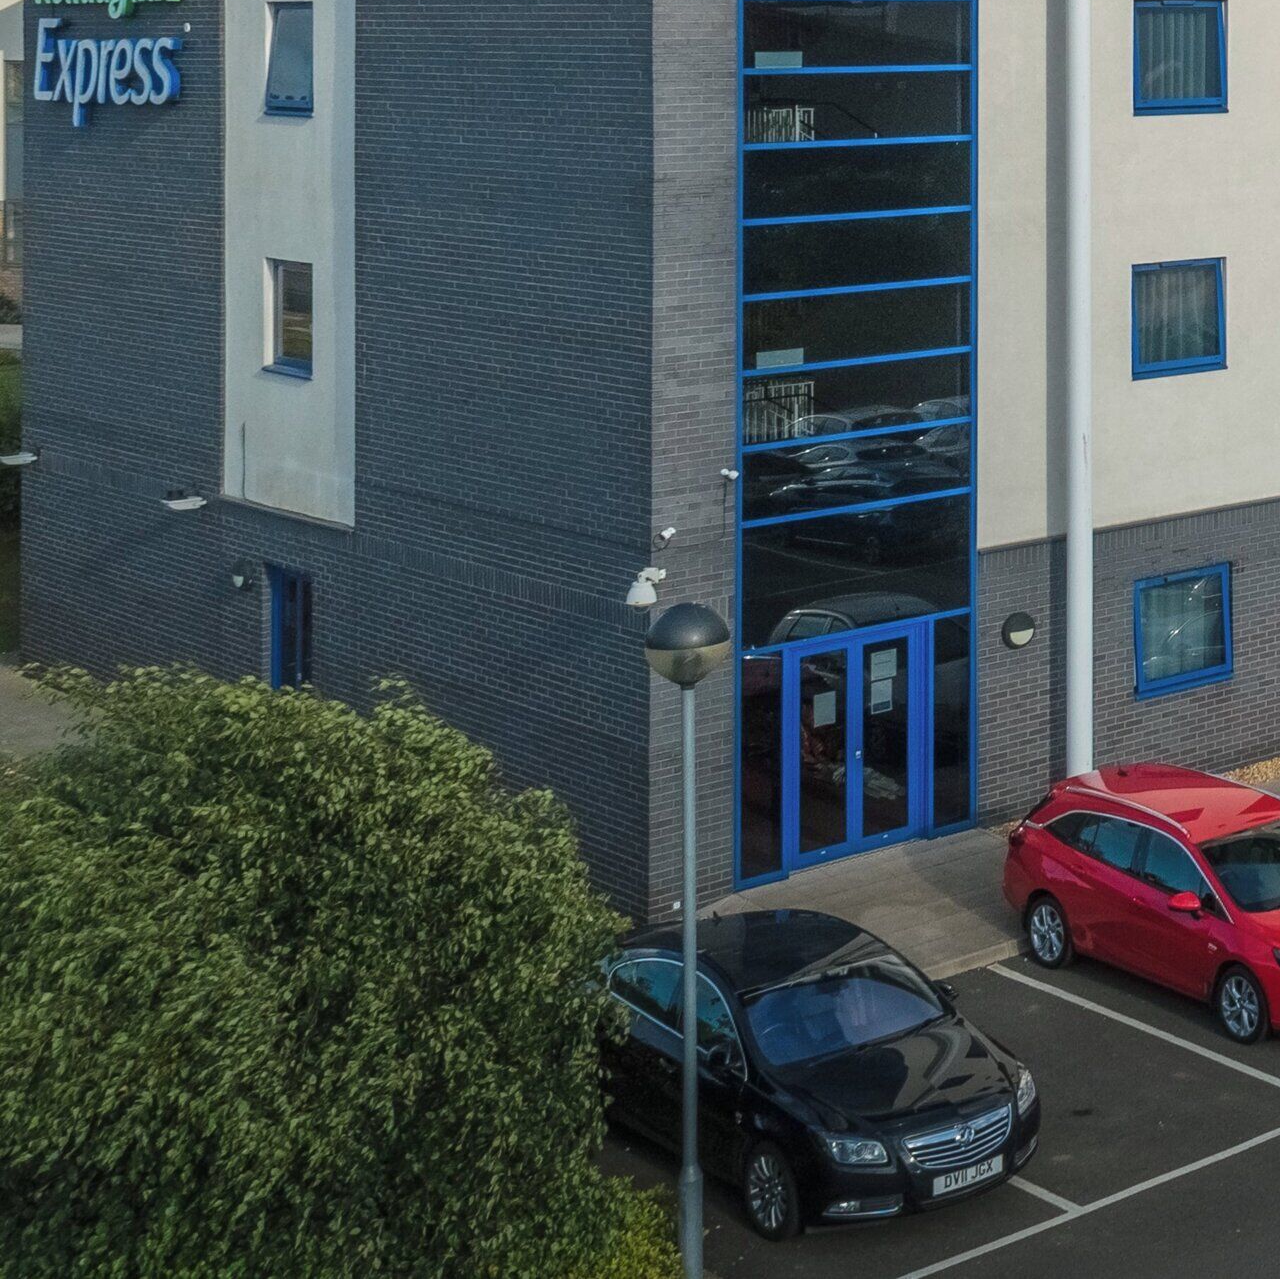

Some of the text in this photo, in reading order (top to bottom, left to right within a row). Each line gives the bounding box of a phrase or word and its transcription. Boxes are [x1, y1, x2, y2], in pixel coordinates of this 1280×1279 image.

[34, 18, 183, 127] Express
[944, 1160, 993, 1189] DV11 JGX
